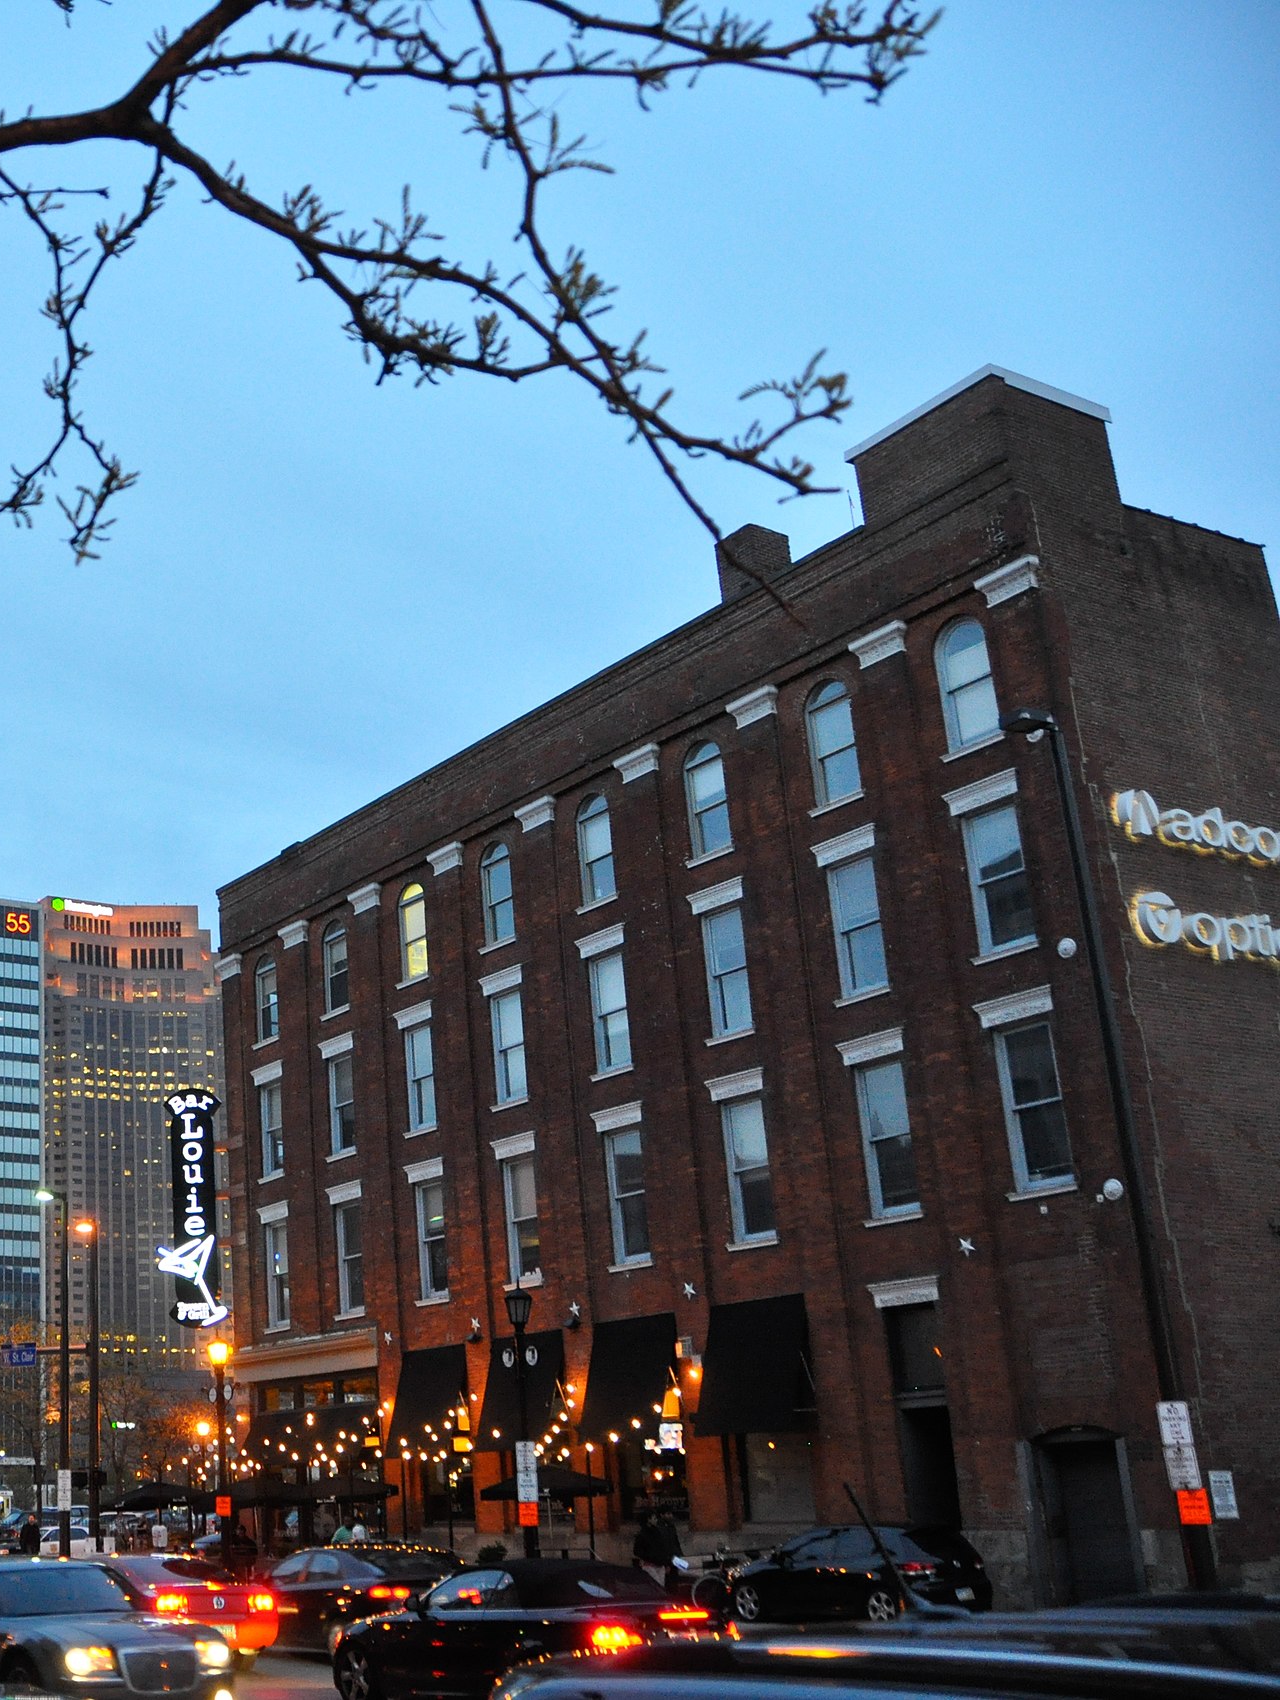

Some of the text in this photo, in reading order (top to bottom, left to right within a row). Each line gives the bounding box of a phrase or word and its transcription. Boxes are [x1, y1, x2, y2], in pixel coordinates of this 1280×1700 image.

[5, 912, 31, 934] 55
[168, 1094, 214, 1115] Bar
[180, 1113, 206, 1237] Louie
